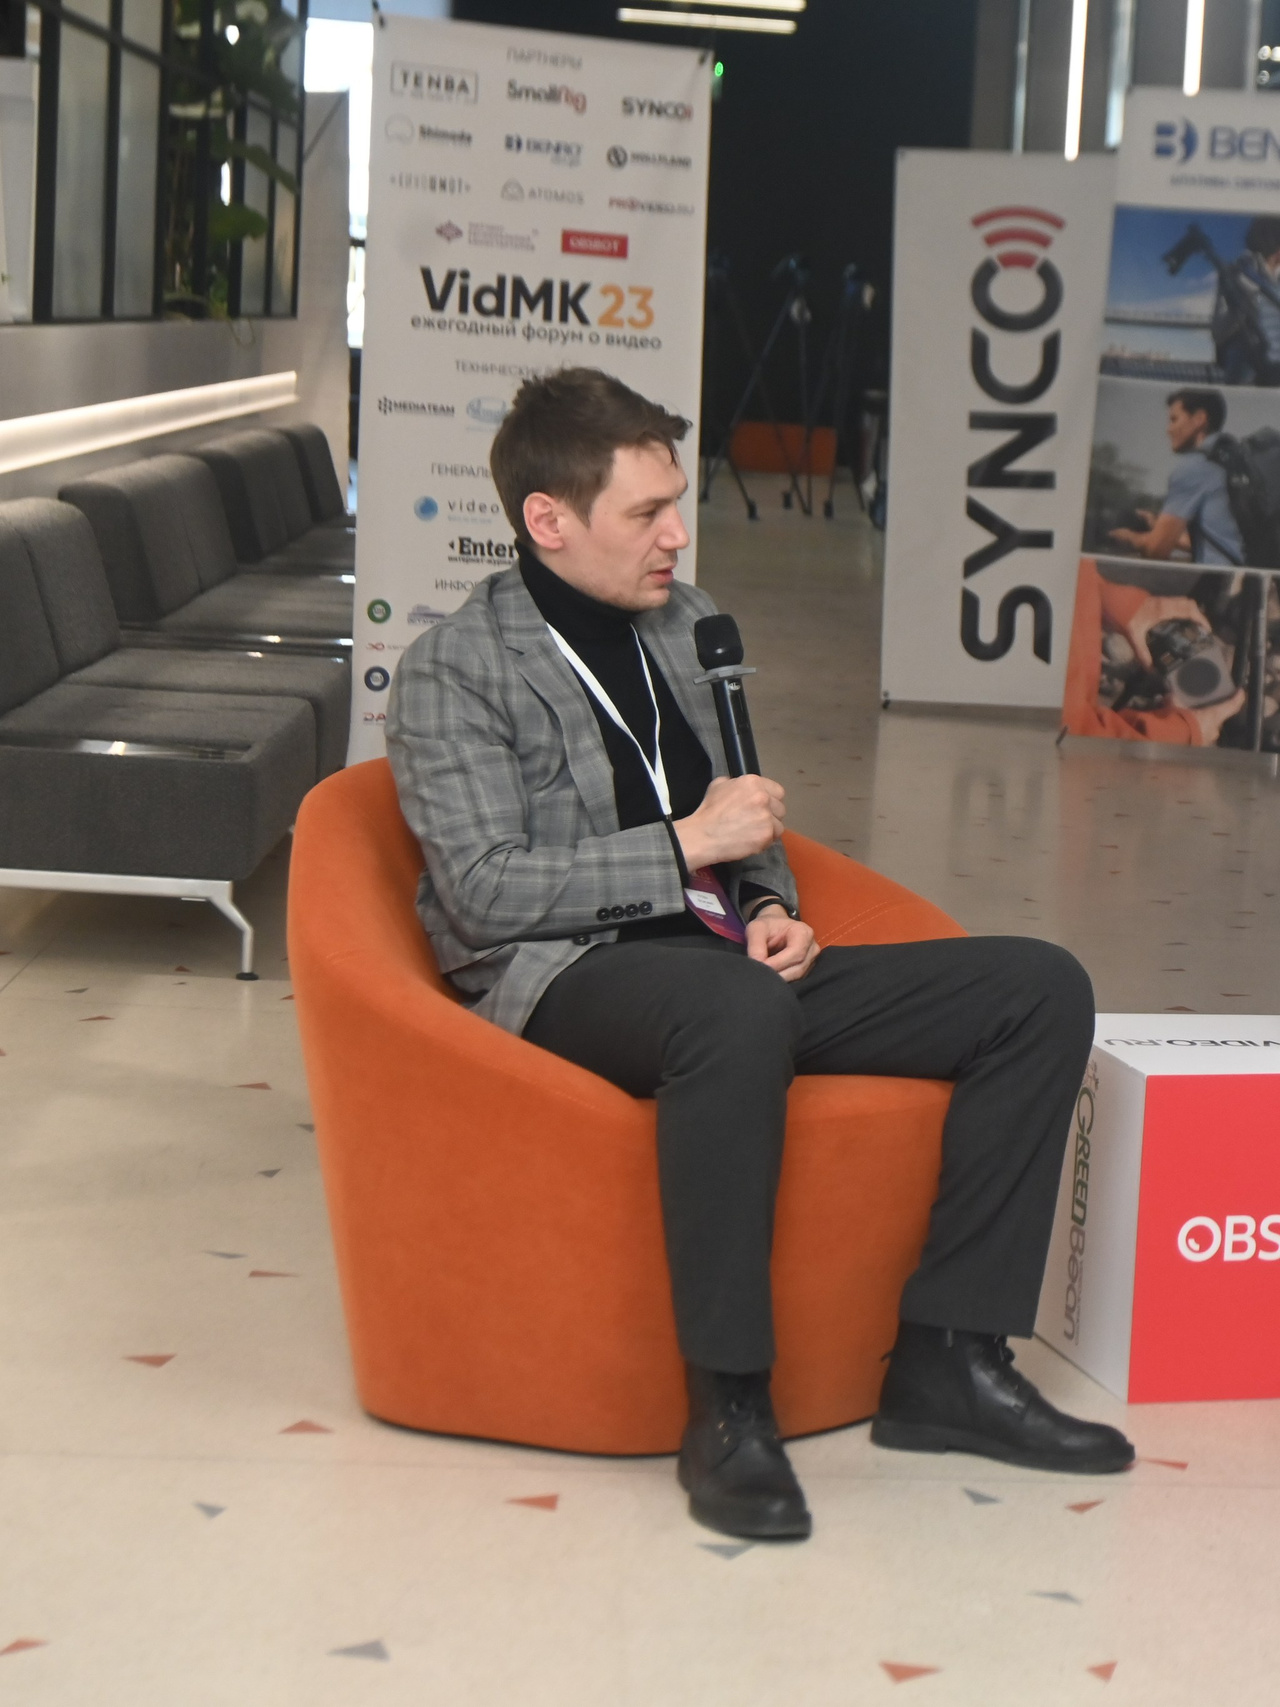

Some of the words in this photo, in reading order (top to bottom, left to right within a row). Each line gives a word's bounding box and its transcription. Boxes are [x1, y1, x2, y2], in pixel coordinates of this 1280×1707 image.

[402, 70, 469, 94] TENBA
[411, 313, 516, 337] ежегодный
[522, 322, 583, 347] форум
[588, 330, 600, 343] о
[605, 334, 663, 351] видео
[960, 256, 1063, 665] SYNCO
[448, 498, 500, 514] video
[458, 536, 516, 558] Enter
